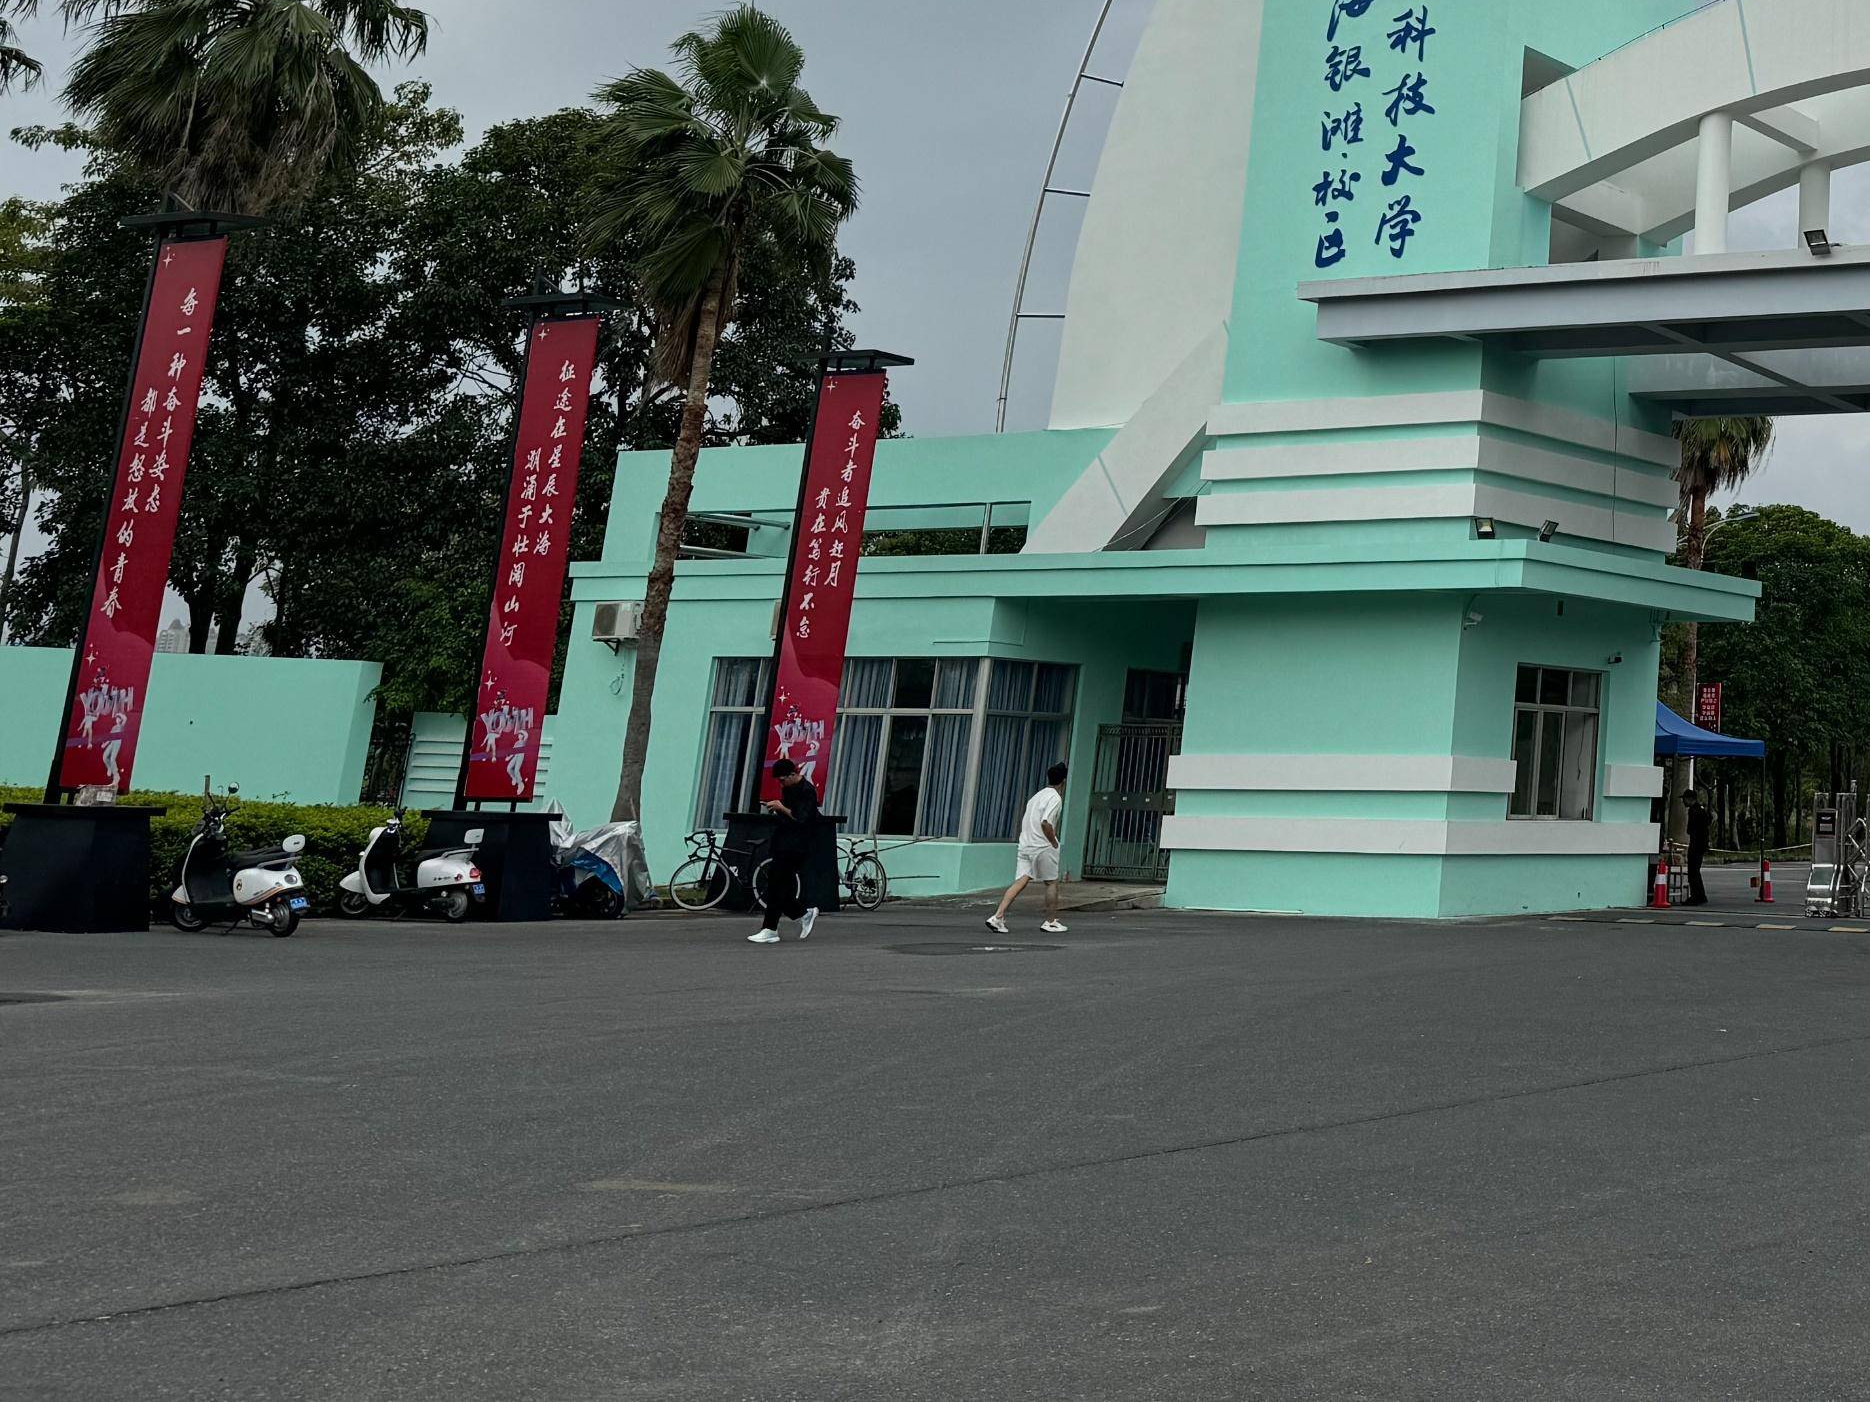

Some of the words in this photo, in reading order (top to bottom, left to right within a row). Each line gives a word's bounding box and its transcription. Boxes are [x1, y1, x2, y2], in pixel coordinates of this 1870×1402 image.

[145, 287, 199, 515] 每一种奋斗姿态
[533, 359, 576, 557] 征途在星辰大海
[823, 409, 867, 588] 奋斗者追风赶月
[100, 387, 158, 619] 都是怒放的青春
[499, 446, 542, 648] 潮涌于壮阔山河
[796, 486, 830, 639] 贵在笃行不怠
